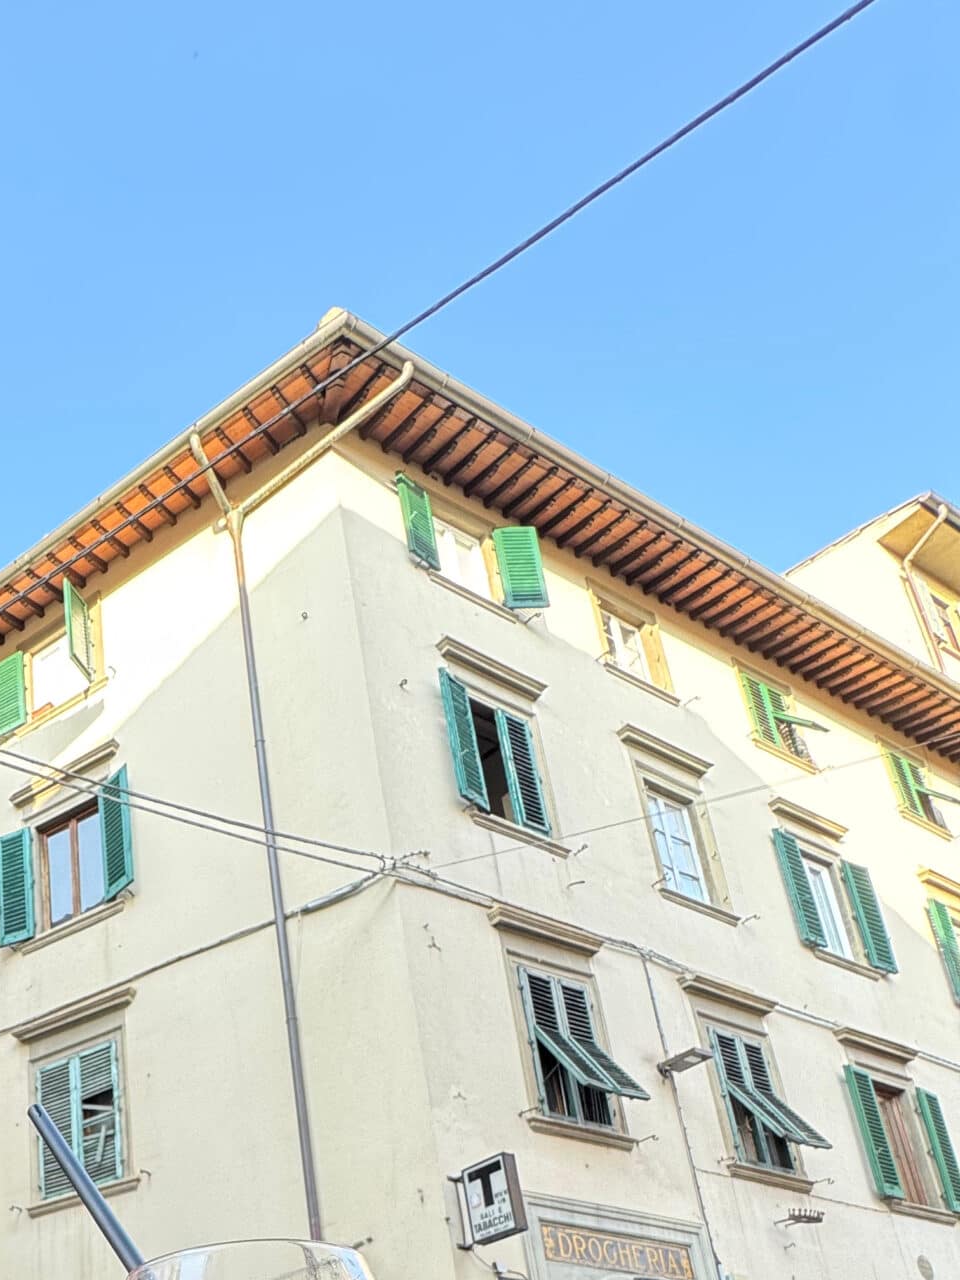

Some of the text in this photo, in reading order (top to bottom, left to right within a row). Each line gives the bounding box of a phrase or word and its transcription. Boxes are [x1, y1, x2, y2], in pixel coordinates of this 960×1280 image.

[467, 1159, 502, 1208] T
[473, 1211, 513, 1234] TABACCHI
[557, 1230, 680, 1275] DROGHERIA
